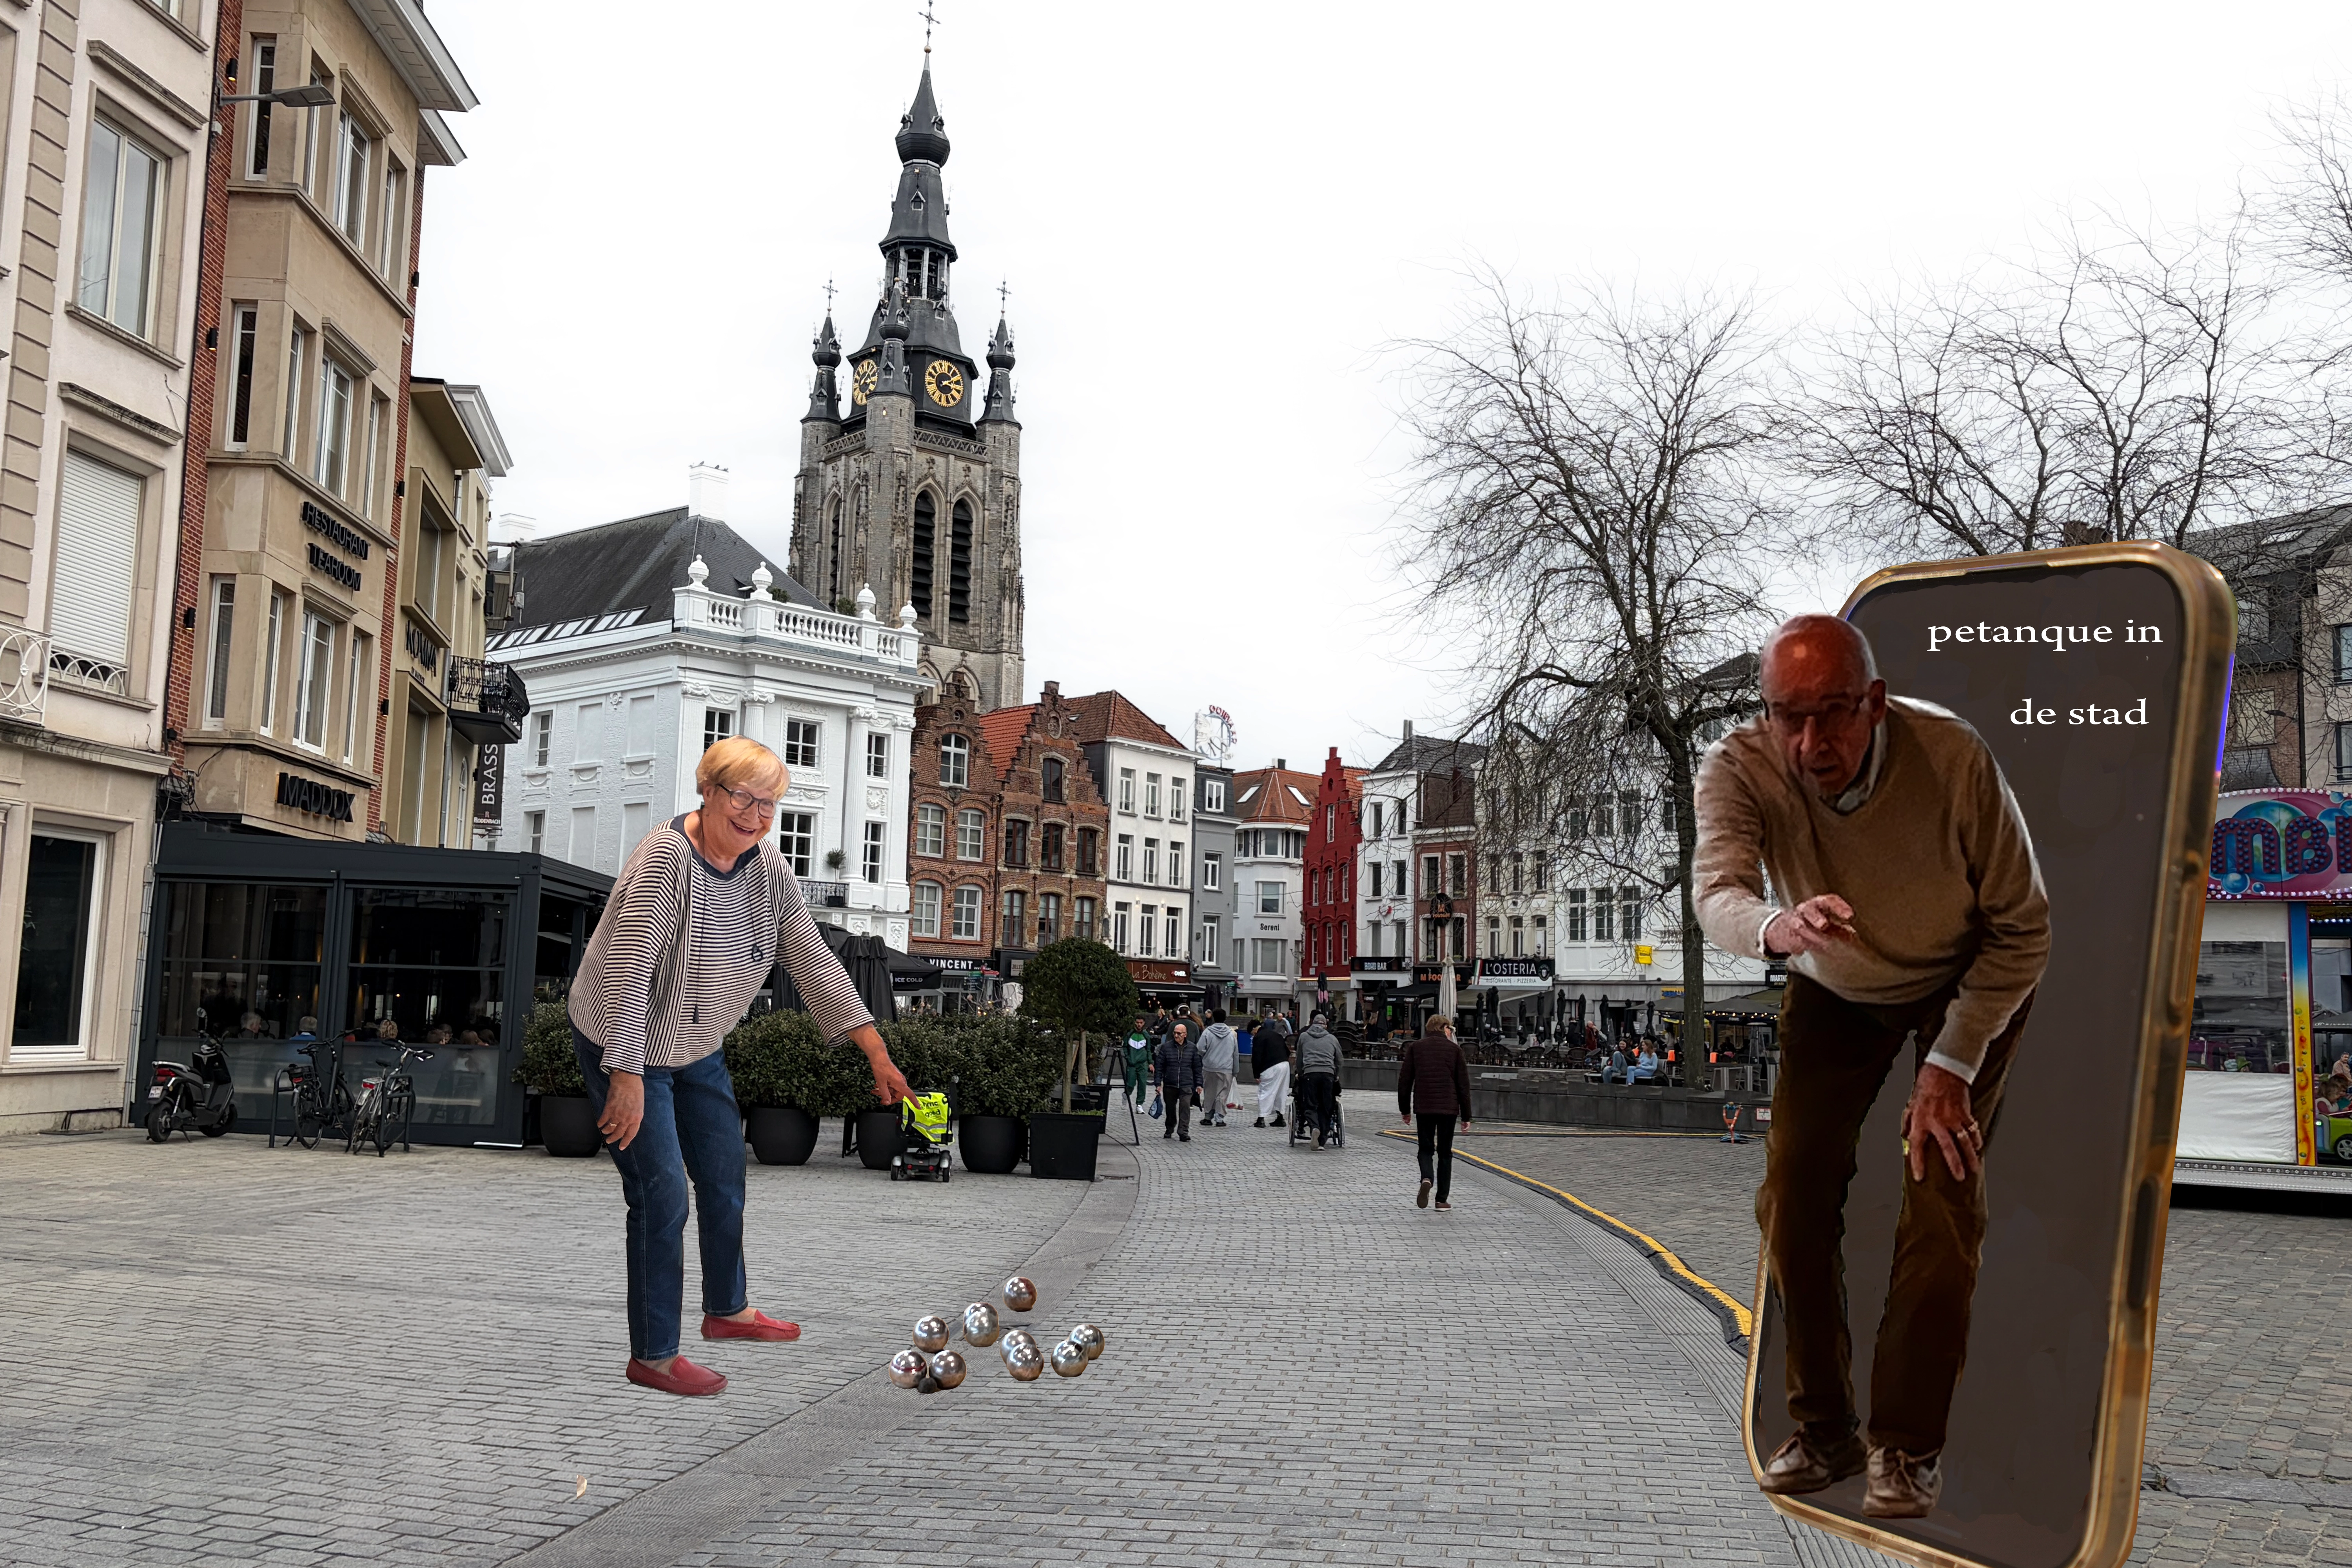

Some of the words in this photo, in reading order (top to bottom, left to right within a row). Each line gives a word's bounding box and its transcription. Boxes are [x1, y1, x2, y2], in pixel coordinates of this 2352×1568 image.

[301, 501, 371, 560] RESTAURANT
[308, 543, 361, 591] TEAROOM
[277, 772, 355, 822] MADDOX
[929, 959, 973, 970] VINCENT
[1131, 962, 1140, 978] La
[1141, 964, 1167, 980] Bohème
[1486, 963, 1537, 975] L'OSTERIA
